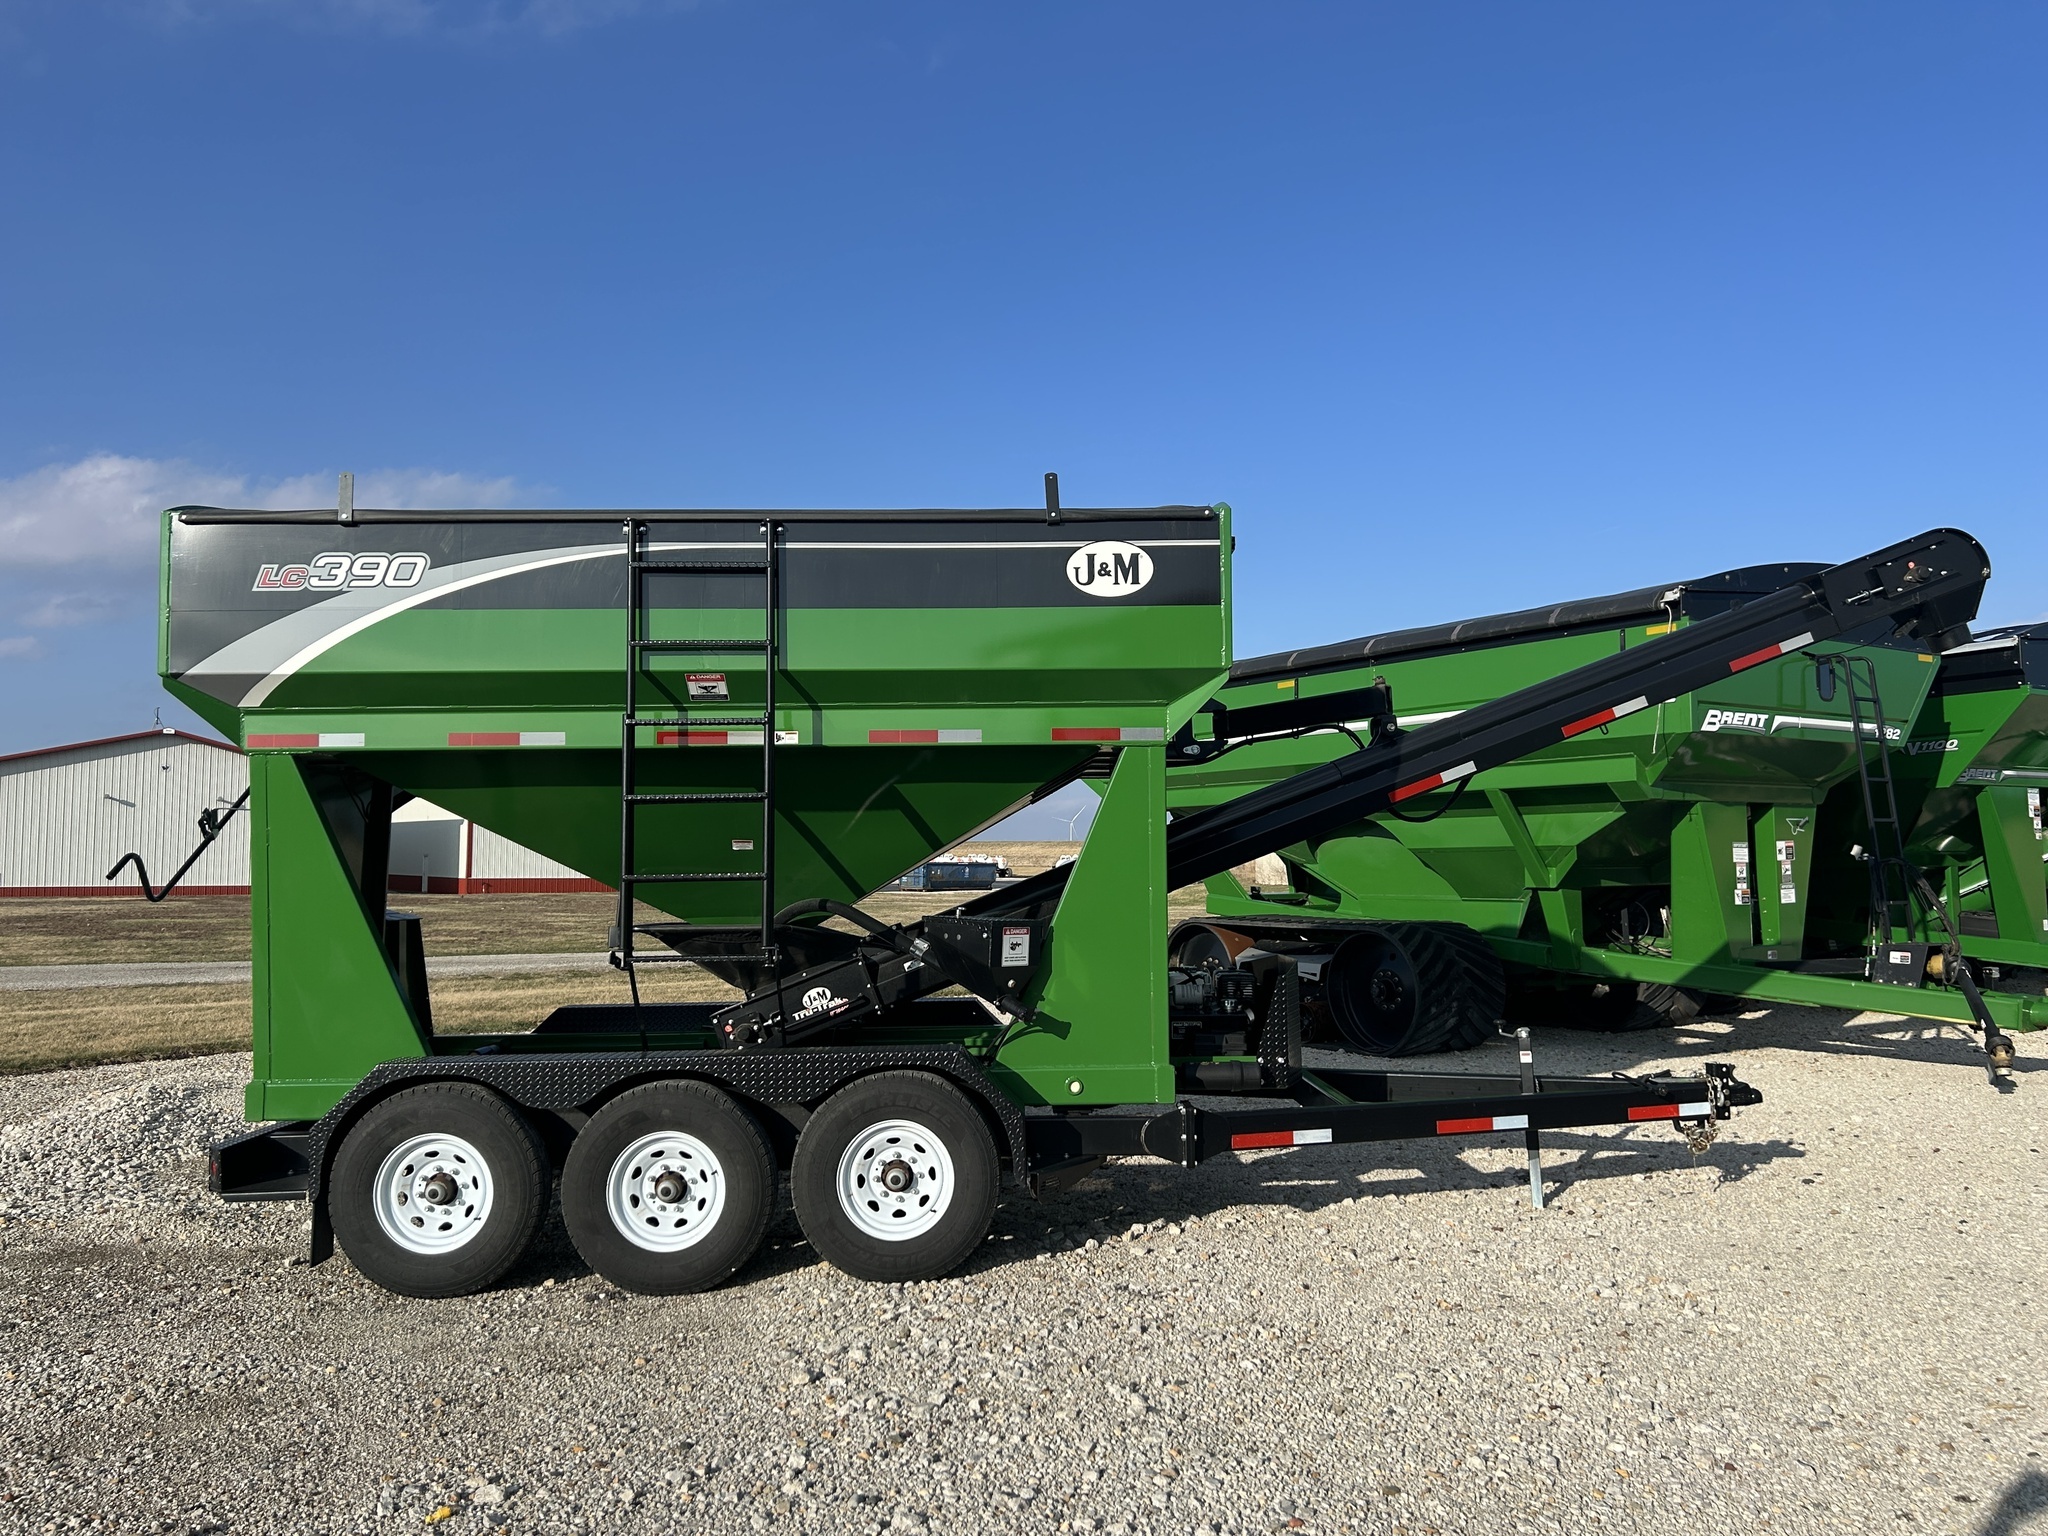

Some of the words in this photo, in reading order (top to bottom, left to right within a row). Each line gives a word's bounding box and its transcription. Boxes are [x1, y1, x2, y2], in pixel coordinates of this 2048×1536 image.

[1073, 553, 1141, 586] J&M
[1701, 709, 1769, 732] BRENT
[1874, 727, 1901, 740] 182
[1906, 739, 1959, 756] V1100
[805, 989, 829, 1006] J&M
